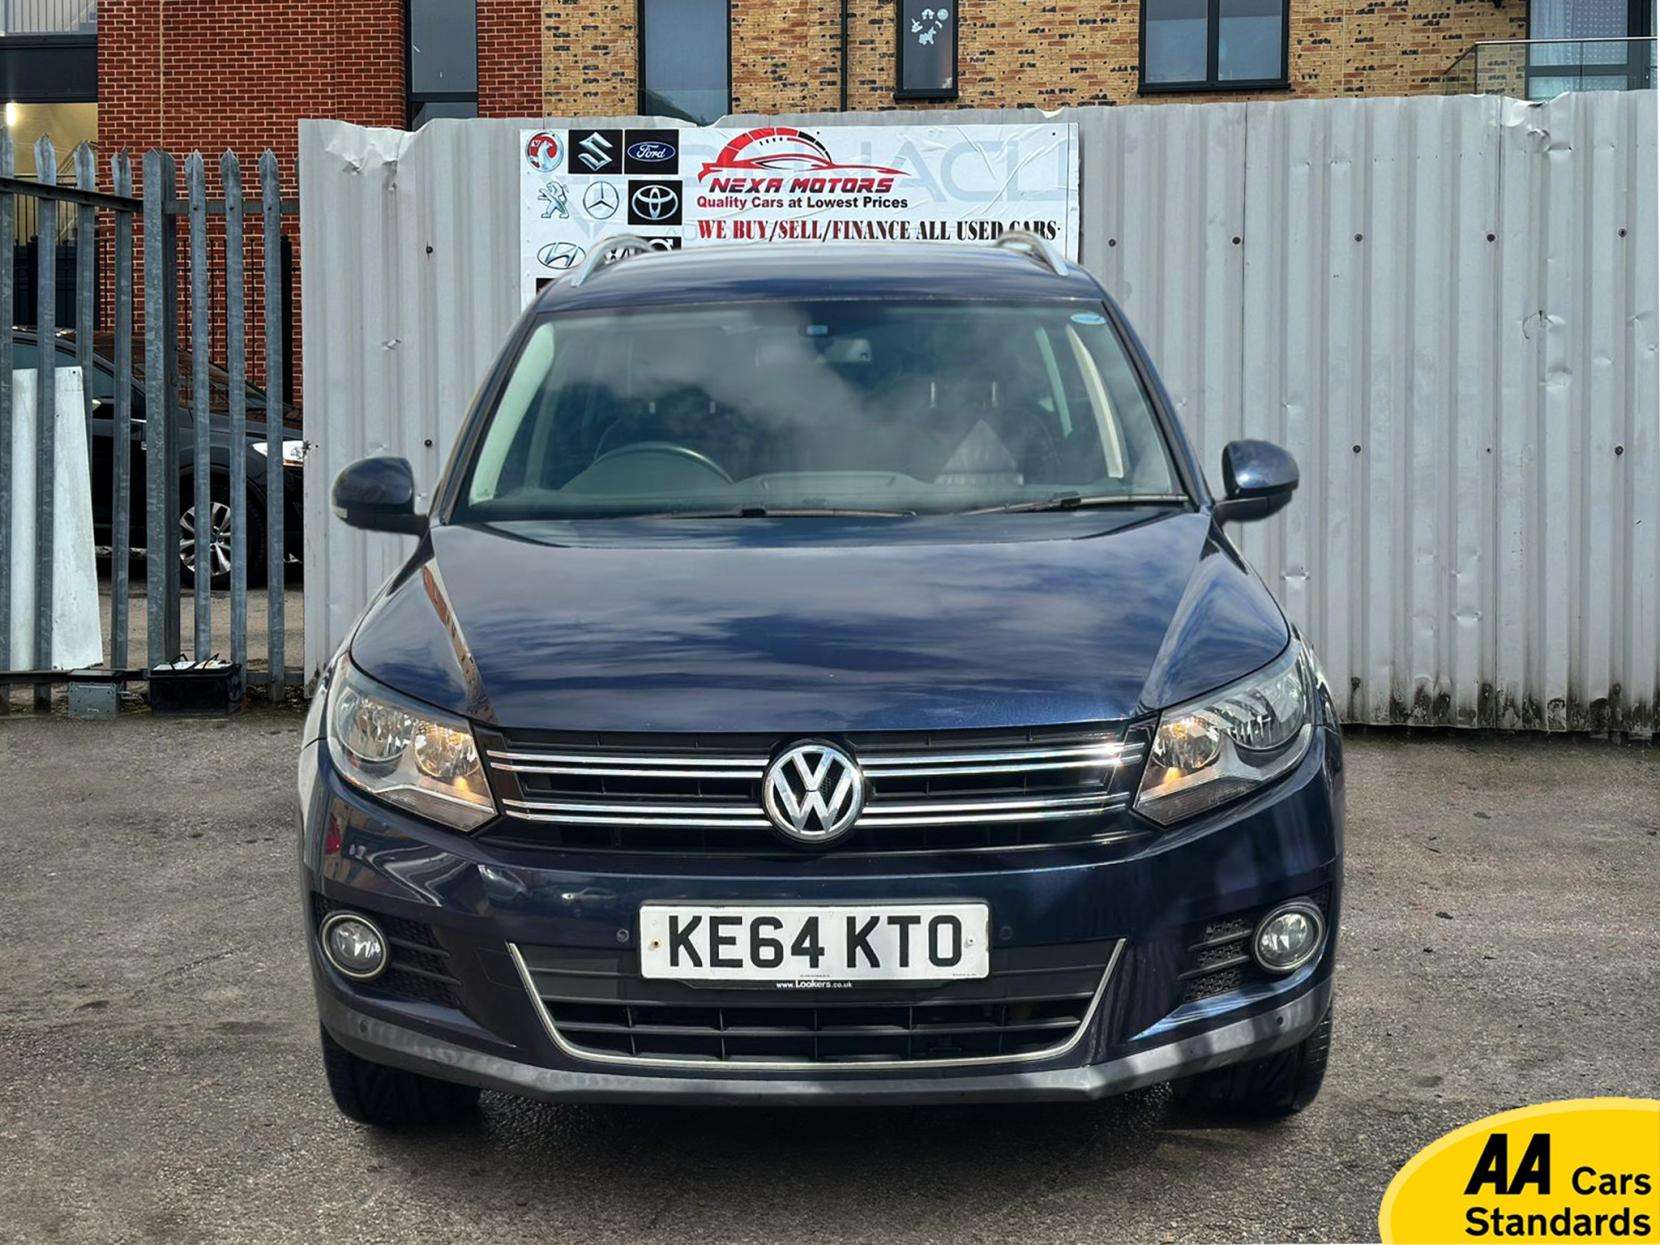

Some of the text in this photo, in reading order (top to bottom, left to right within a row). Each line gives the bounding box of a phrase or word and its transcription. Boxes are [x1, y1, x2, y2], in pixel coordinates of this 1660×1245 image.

[636, 143, 667, 159] Ford
[709, 178, 895, 193] NEXA MOTORS
[697, 195, 908, 210] Quality Cars at Lowest Prices
[697, 220, 727, 240] WE
[732, 220, 910, 243] BUY/SELL/FINANCE
[915, 220, 950, 240] ALL
[957, 219, 1003, 240] USED
[668, 915, 963, 968] KE64 KTO
[776, 980, 853, 989] www.Lookers.co.uk
